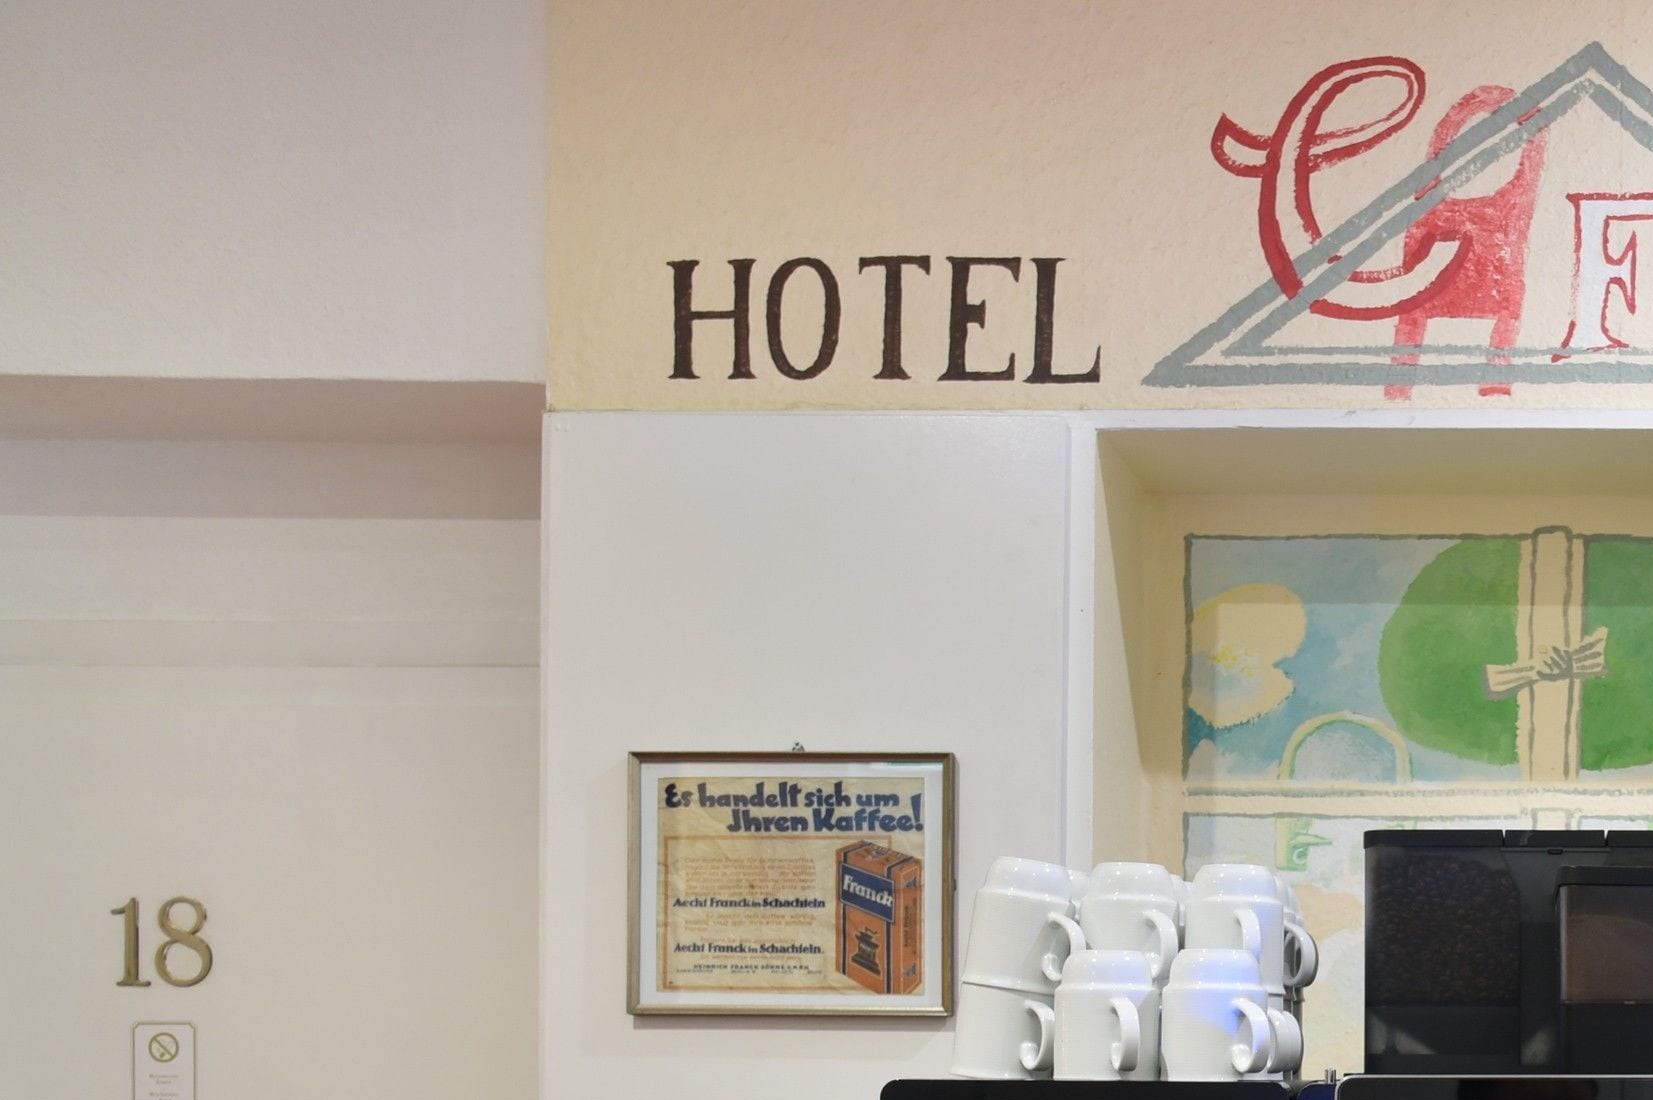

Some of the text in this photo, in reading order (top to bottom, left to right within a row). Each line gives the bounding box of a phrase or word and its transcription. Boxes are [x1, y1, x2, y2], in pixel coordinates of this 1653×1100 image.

[667, 255, 1101, 385] HOTEL
[664, 780, 900, 809] Es handelt sich um
[812, 793, 925, 833] Kaffee!
[110, 895, 213, 988] 18
